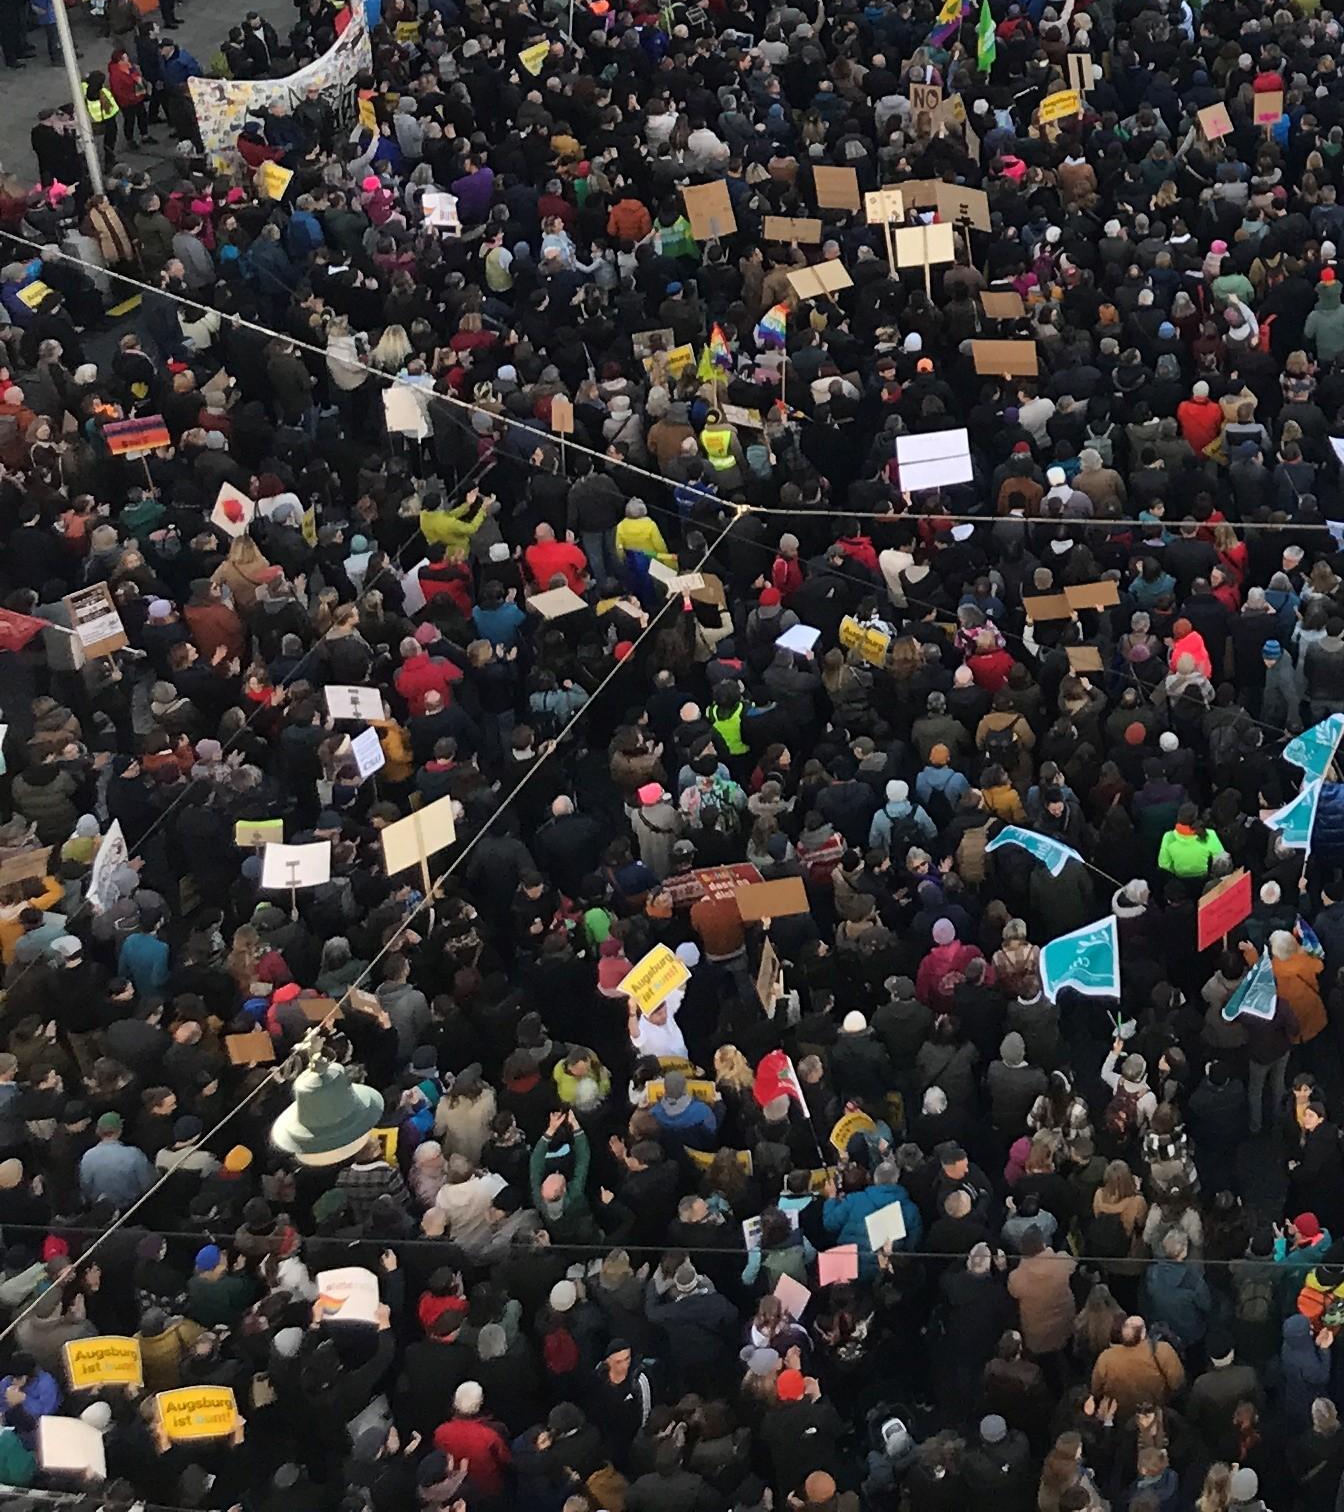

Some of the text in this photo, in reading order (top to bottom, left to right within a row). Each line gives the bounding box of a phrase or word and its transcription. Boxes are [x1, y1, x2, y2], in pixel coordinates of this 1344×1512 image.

[631, 953, 675, 994] Augsburg
[642, 990, 654, 1003] ist
[75, 1345, 138, 1362] Augsburg
[82, 1362, 101, 1375] ist
[166, 1396, 233, 1413] Augsburg
[173, 1415, 191, 1428] ist
